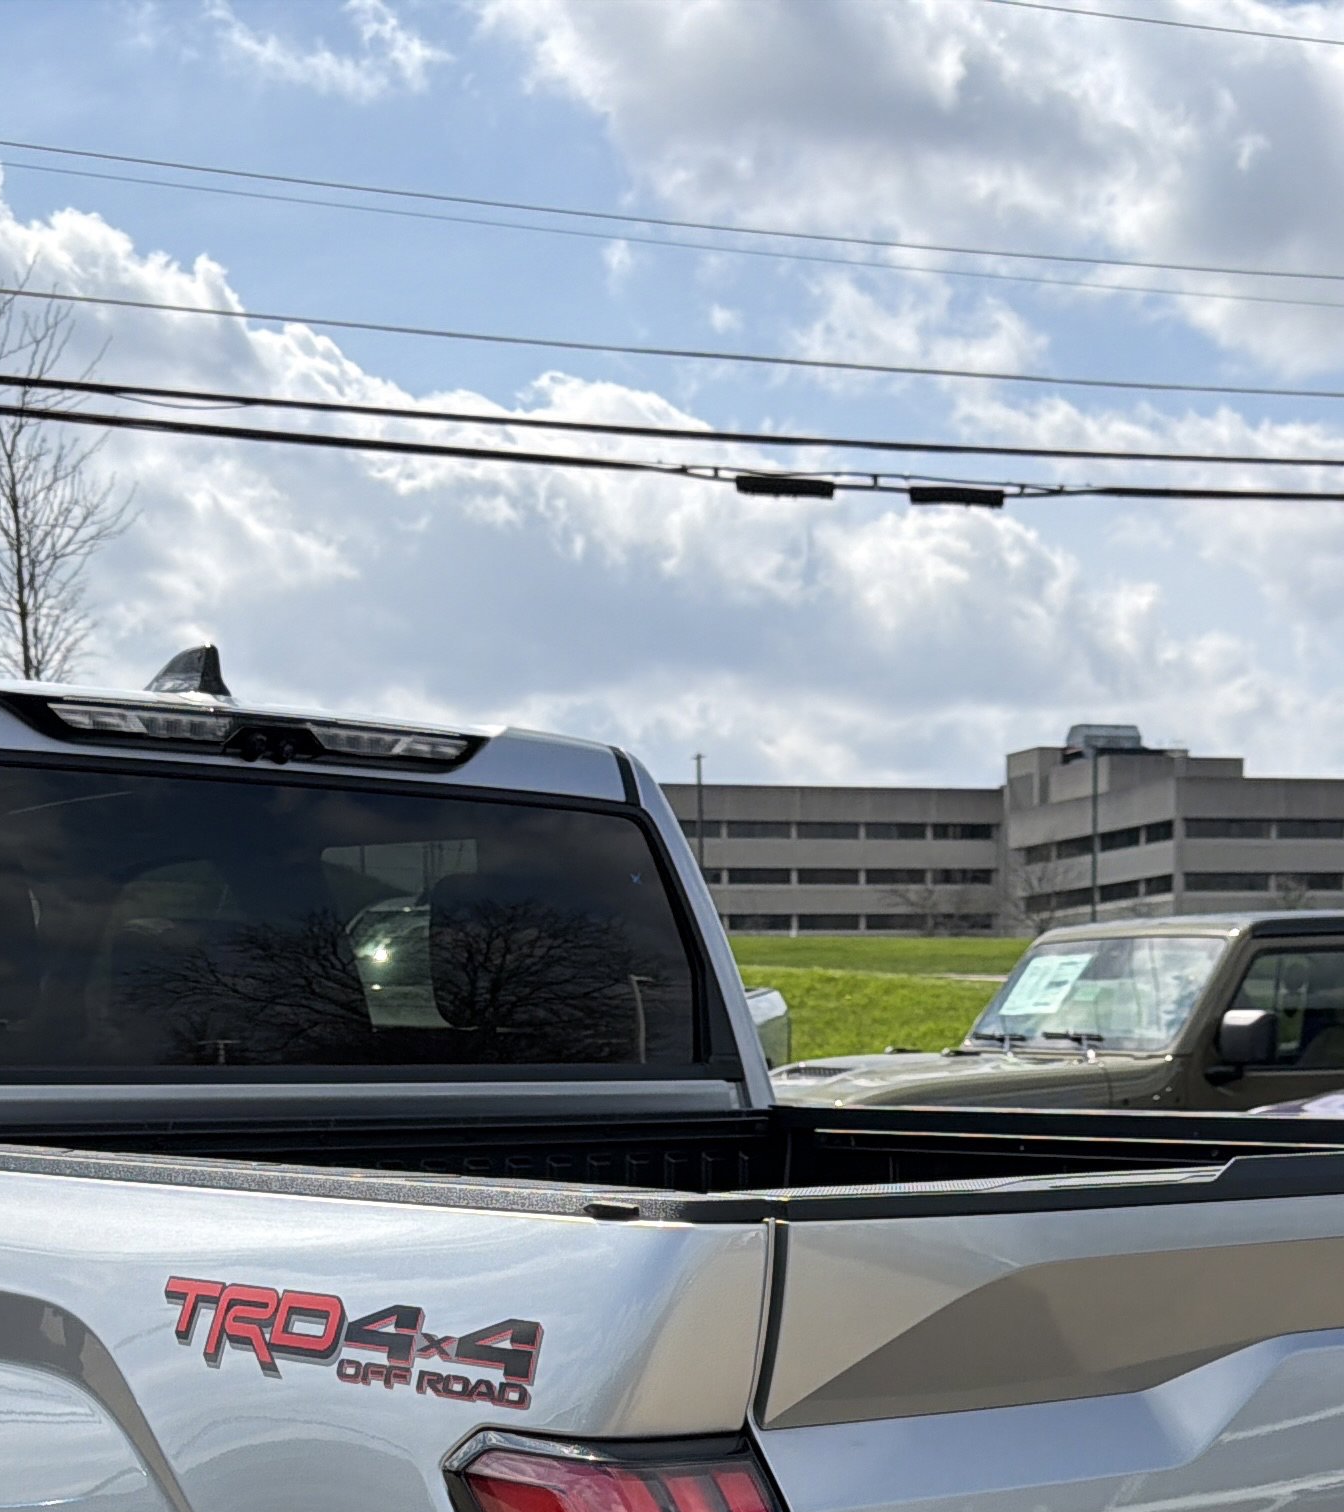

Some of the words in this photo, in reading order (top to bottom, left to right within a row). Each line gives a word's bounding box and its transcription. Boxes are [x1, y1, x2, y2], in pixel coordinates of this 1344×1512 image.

[164, 1276, 348, 1379] TRD
[344, 1304, 544, 1385] 4x4
[336, 1358, 411, 1389] OFF
[416, 1369, 532, 1411] ROAD
